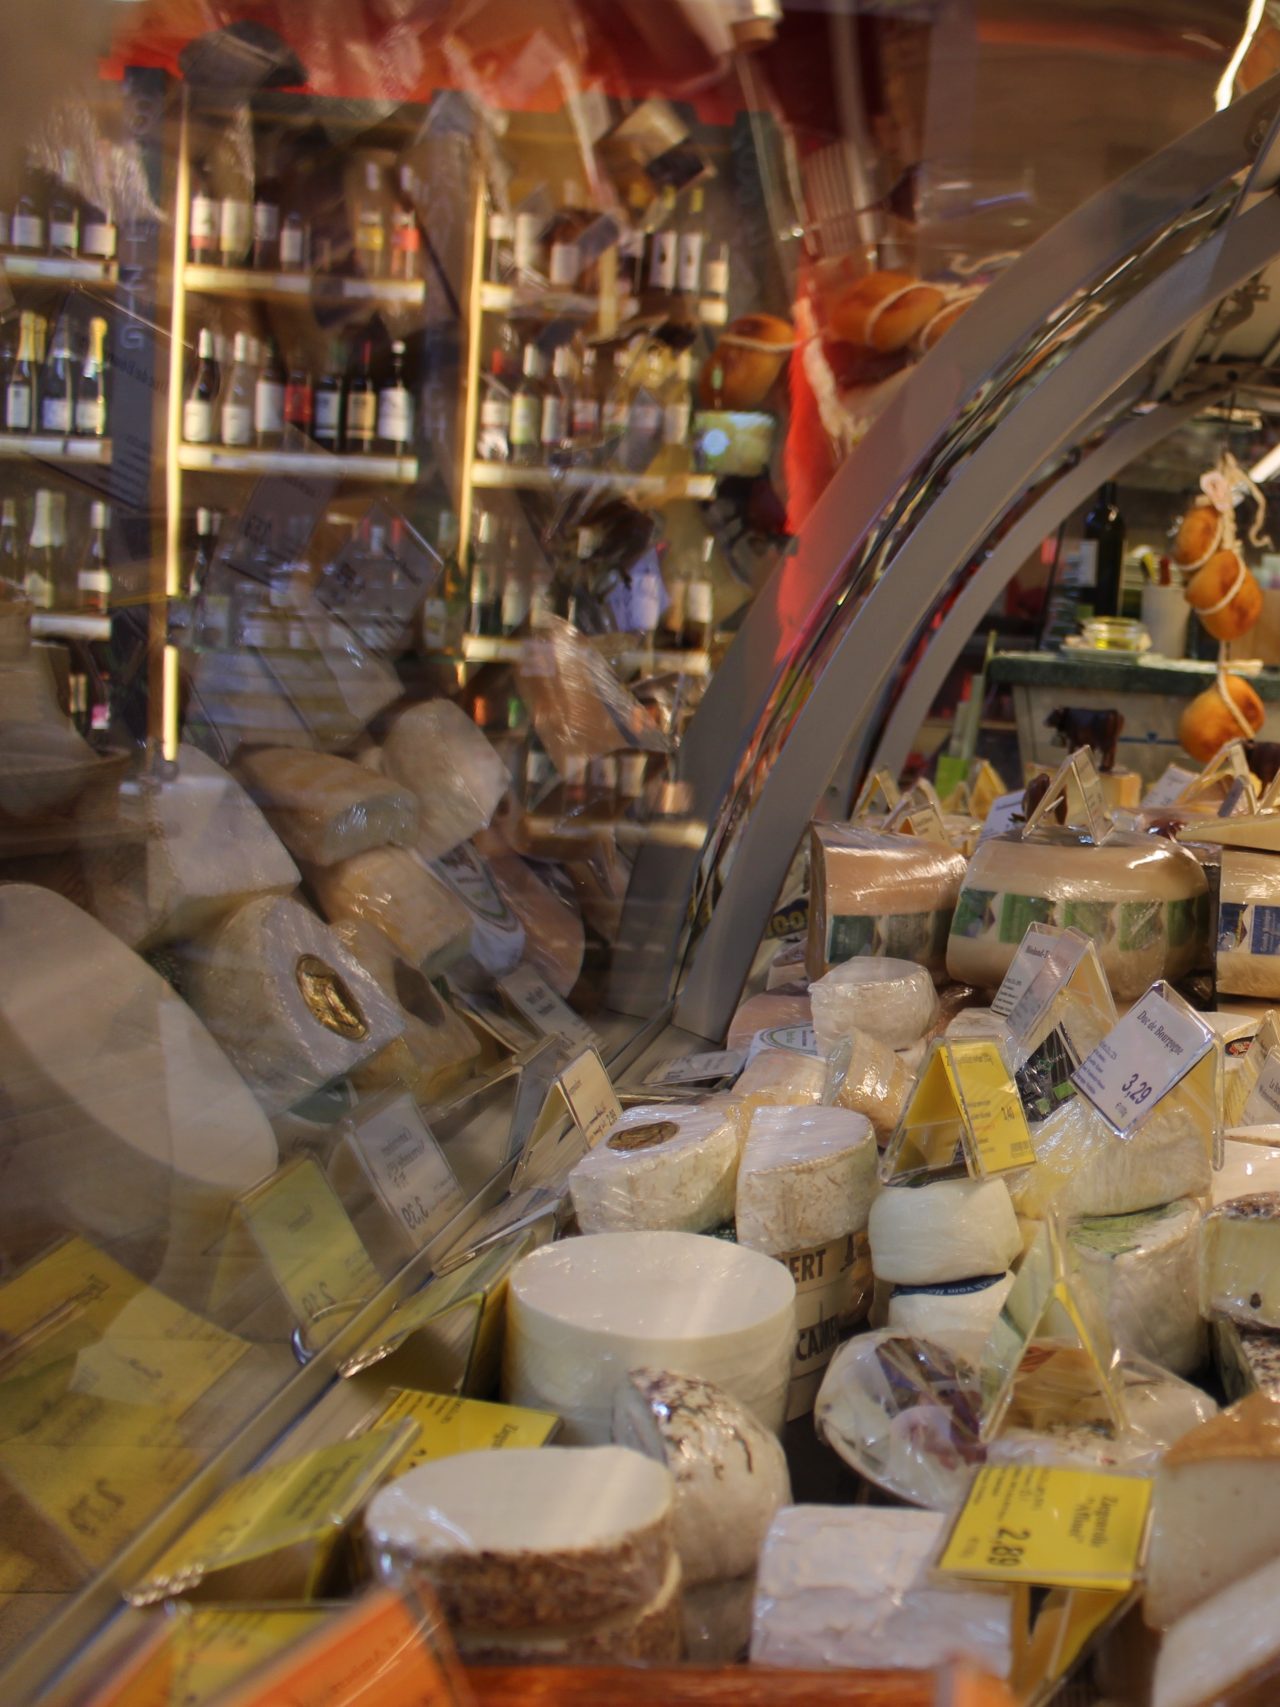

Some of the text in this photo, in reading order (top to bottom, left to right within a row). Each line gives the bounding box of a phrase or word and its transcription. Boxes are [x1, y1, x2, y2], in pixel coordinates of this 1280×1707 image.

[1137, 1009, 1149, 1027] Duc
[1154, 1025, 1184, 1056] Bourgogne
[1121, 1073, 1153, 1105] 3,29
[780, 1249, 827, 1284] ERT
[987, 1526, 1031, 1568] 2,89
